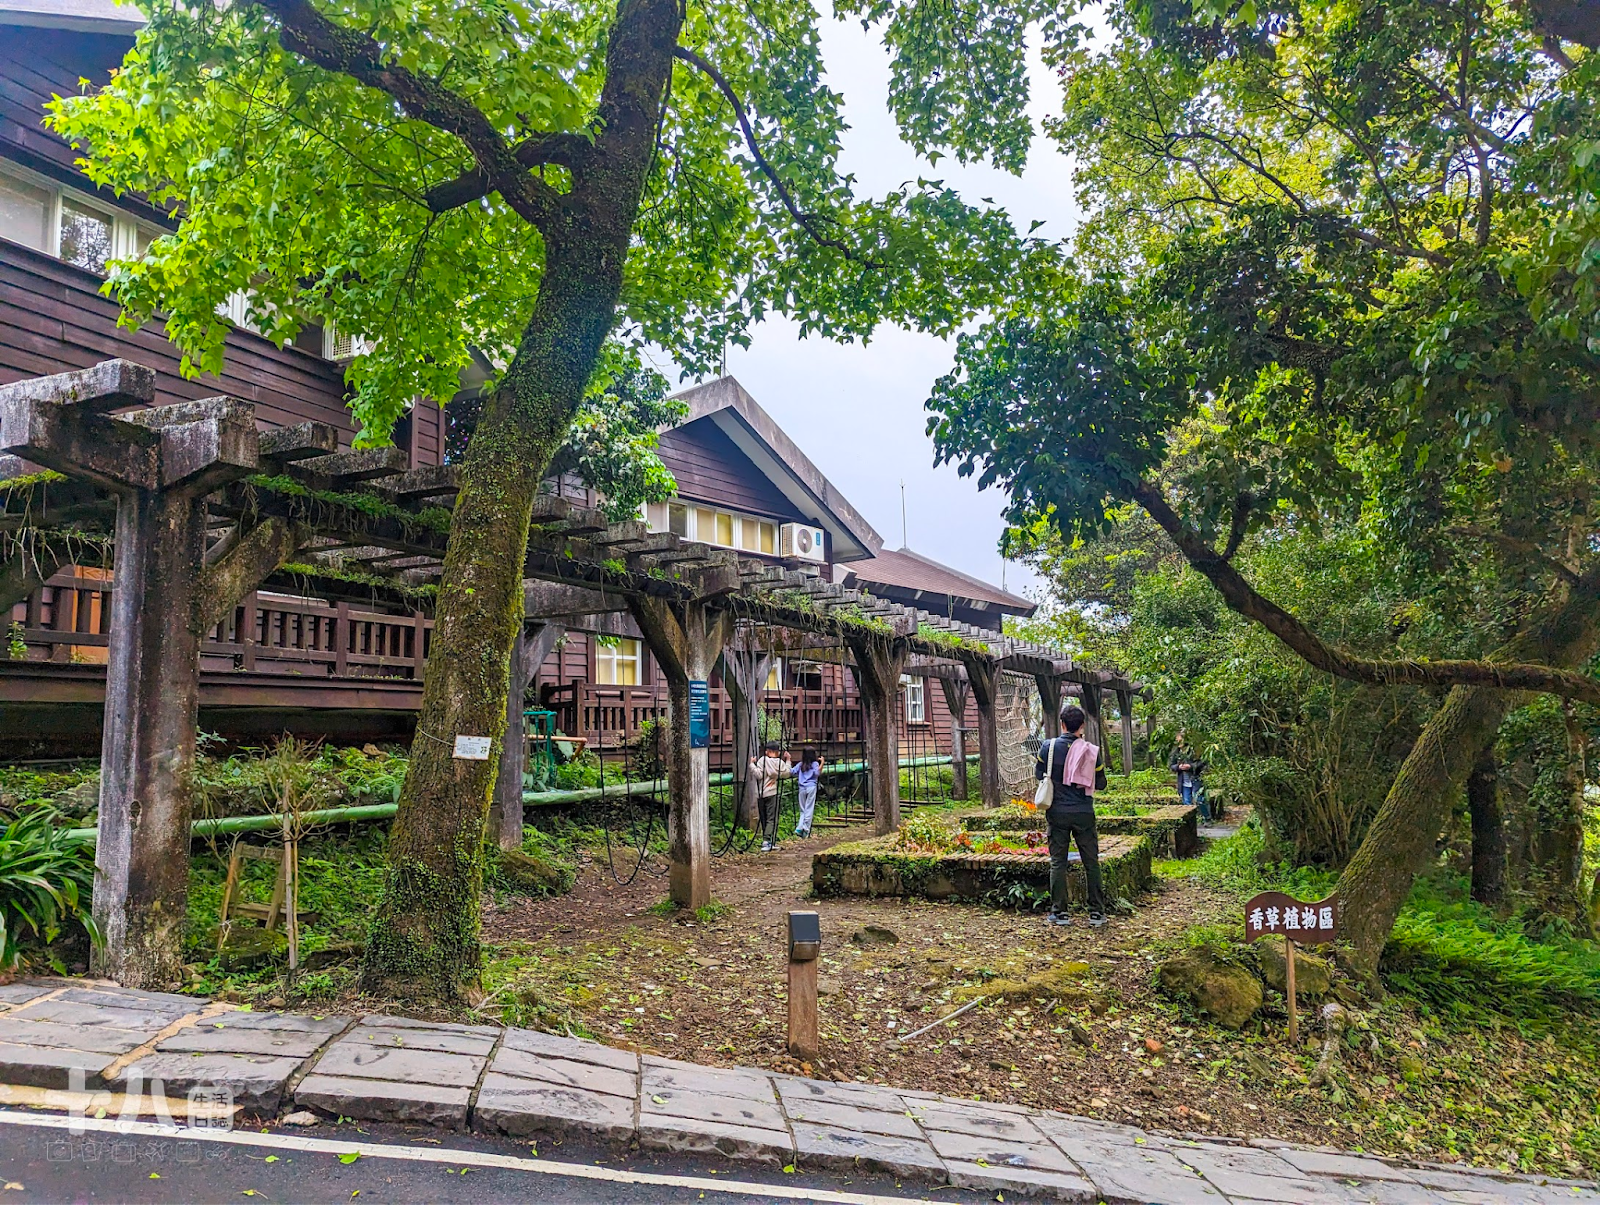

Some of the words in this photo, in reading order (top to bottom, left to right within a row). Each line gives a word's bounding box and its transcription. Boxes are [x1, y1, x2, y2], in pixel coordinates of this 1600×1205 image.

[1248, 906, 1334, 931] 香草植物區
